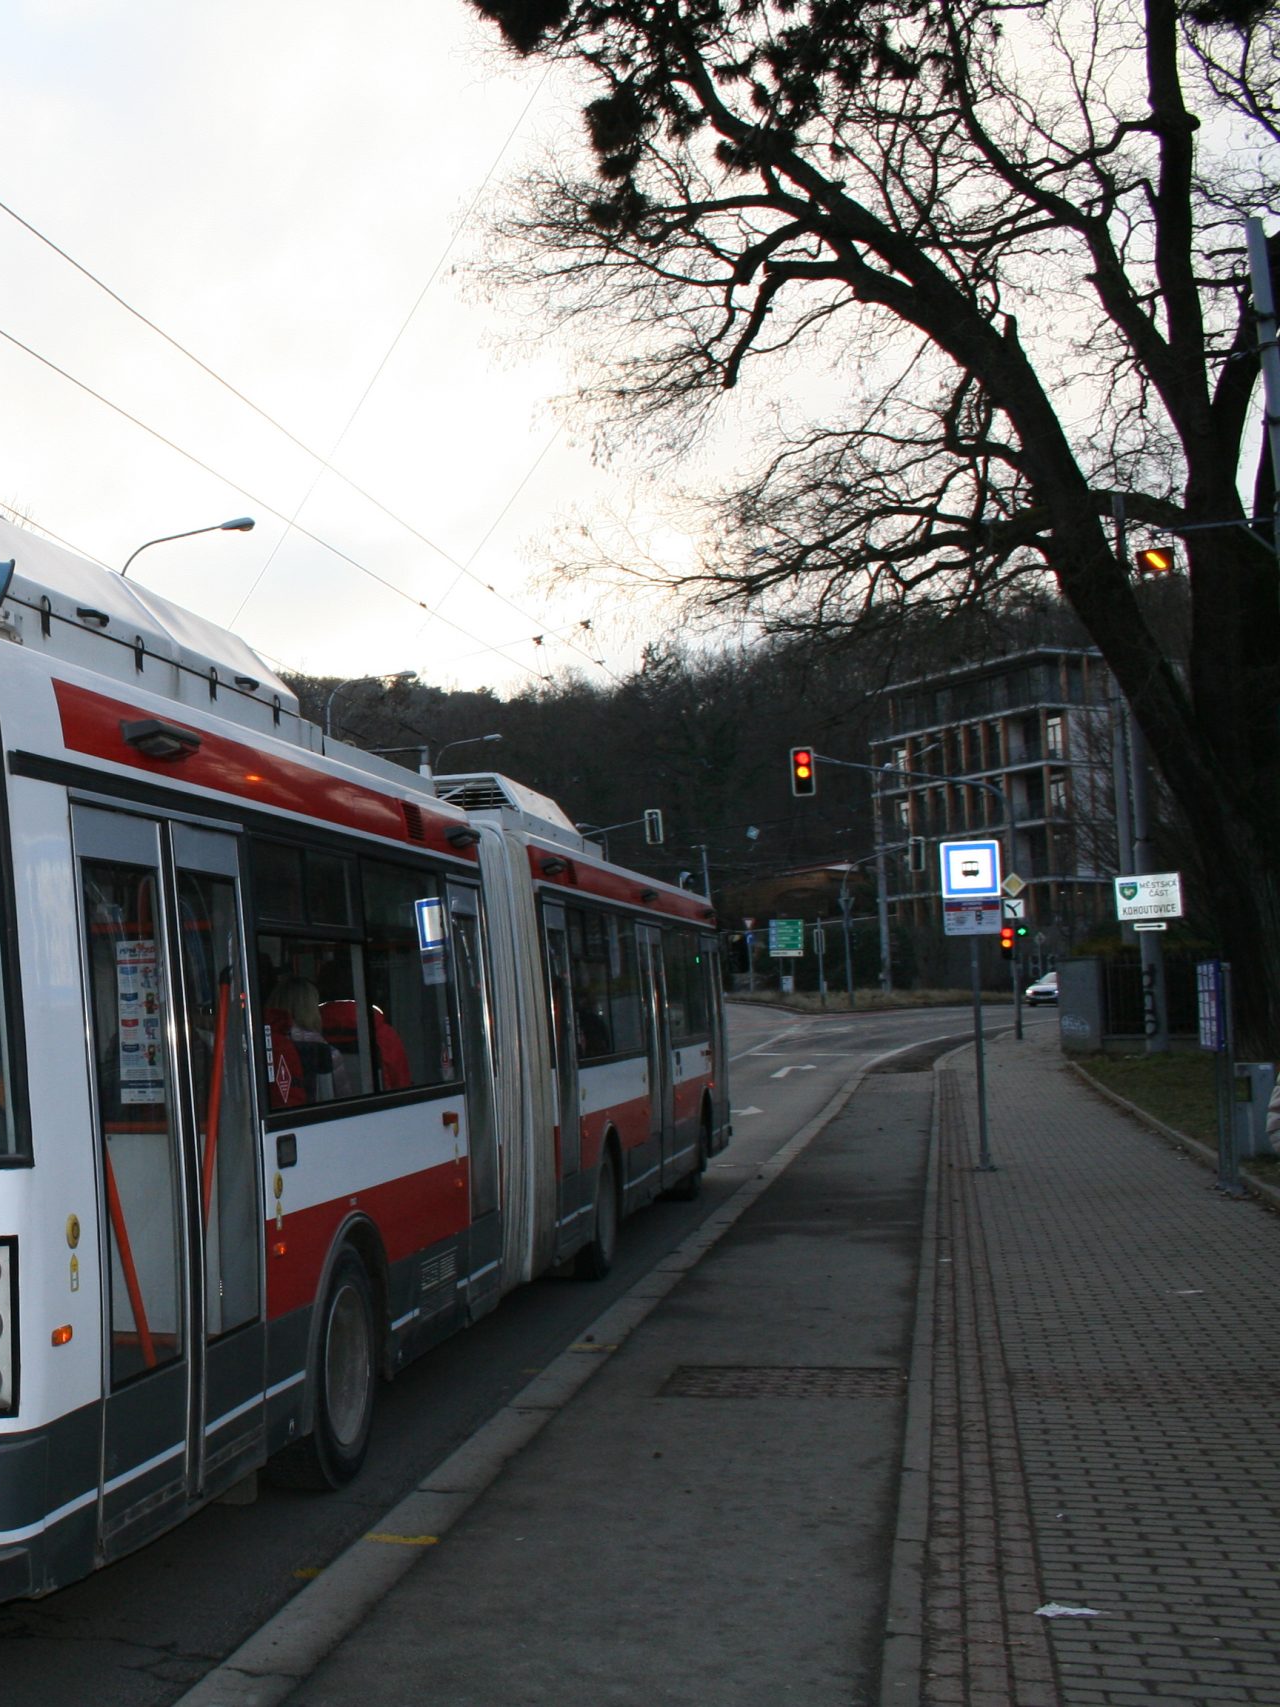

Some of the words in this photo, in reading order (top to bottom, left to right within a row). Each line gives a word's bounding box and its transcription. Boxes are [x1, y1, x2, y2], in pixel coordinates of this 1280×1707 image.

[1139, 879, 1177, 889] MĚSTSKÁ
[1148, 888, 1169, 897] ČÁST
[1122, 903, 1177, 916] KOHOUTOVICE
